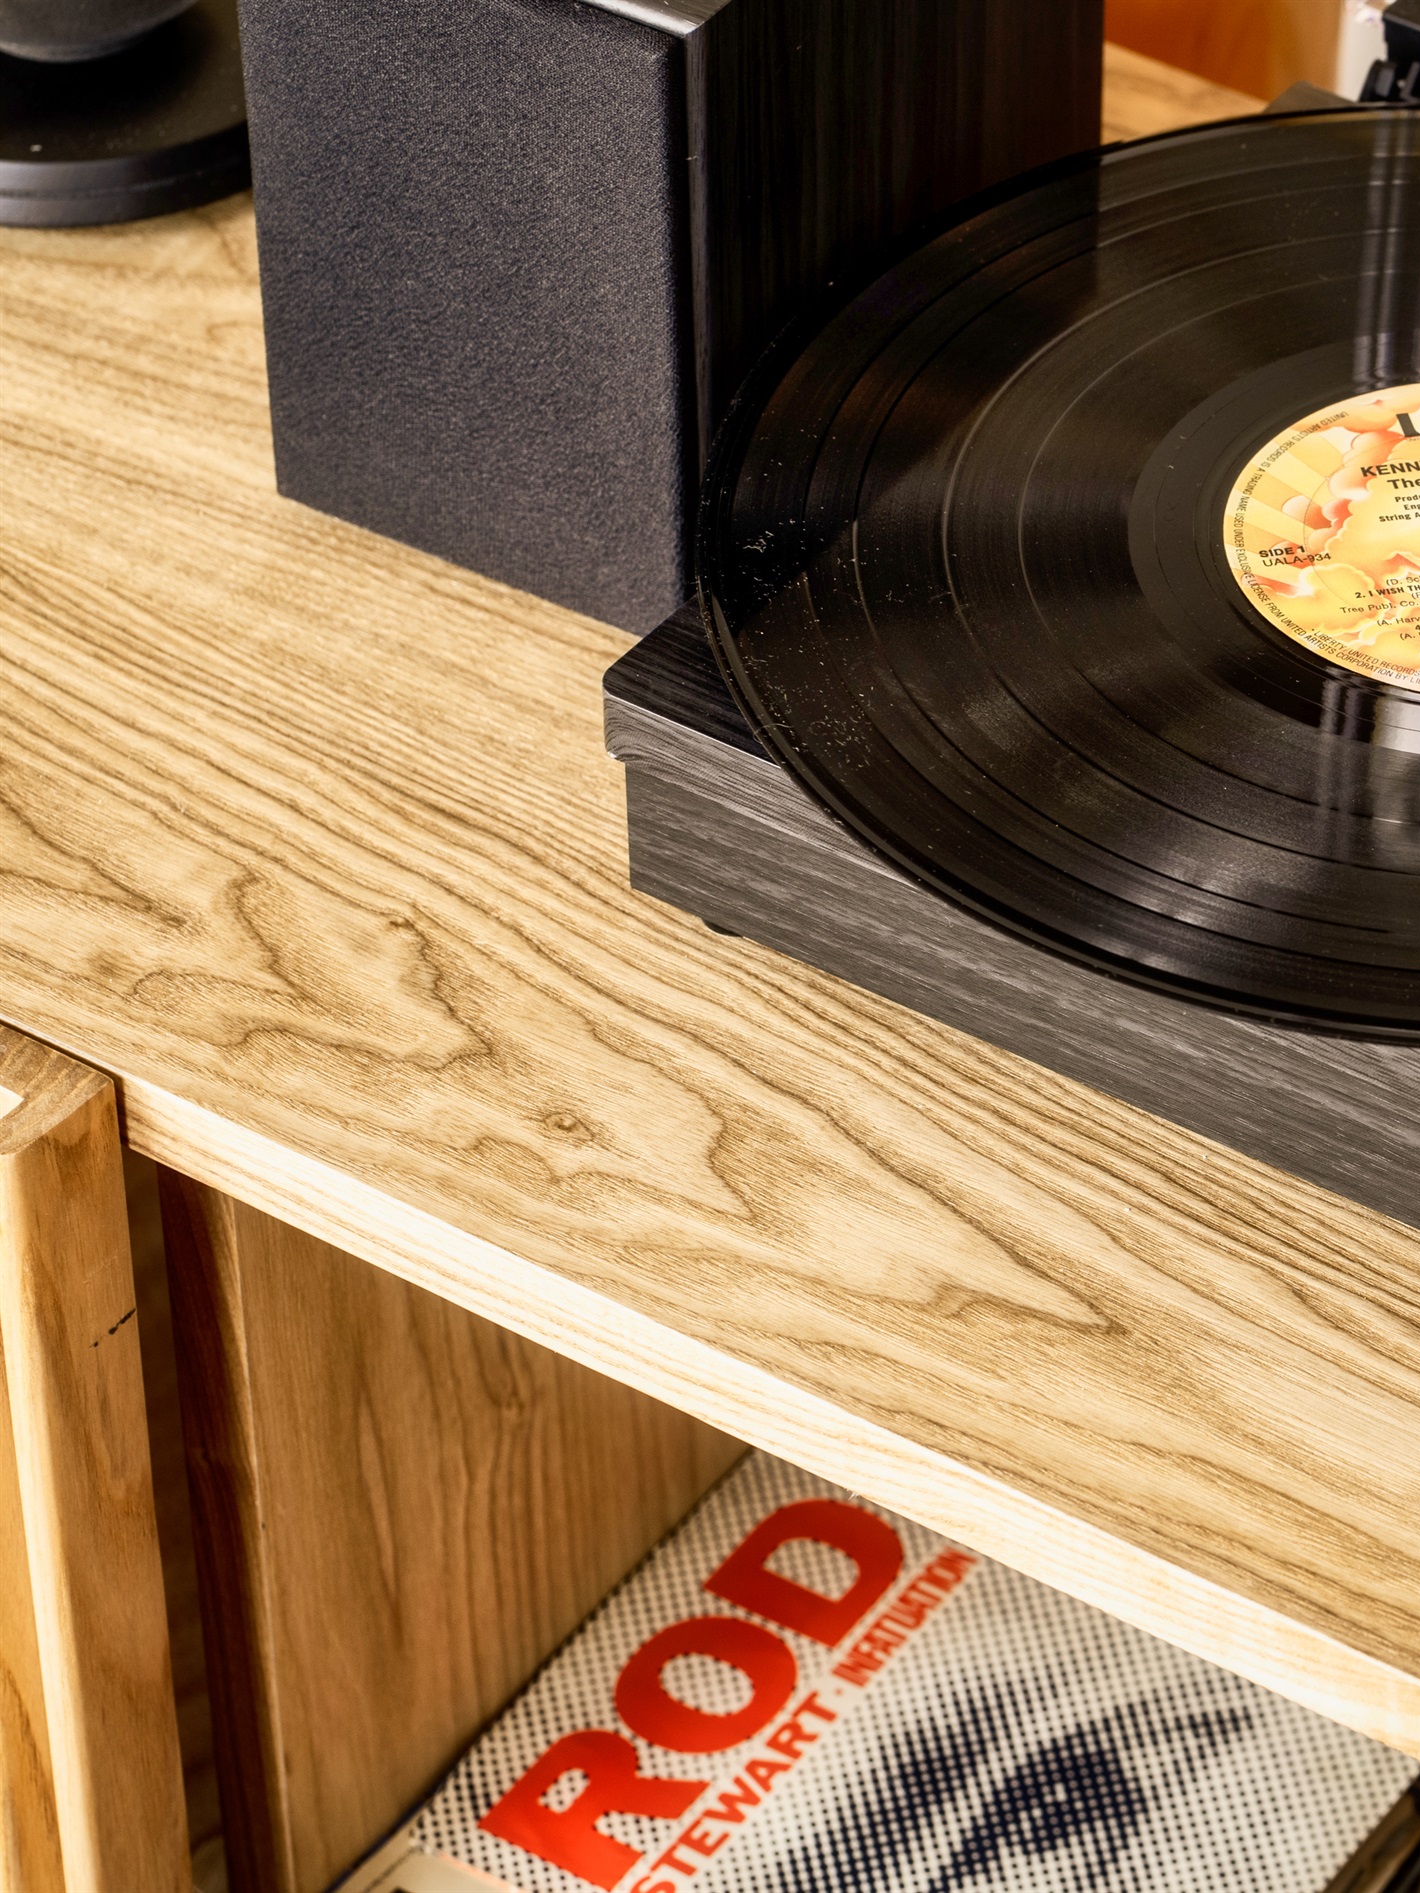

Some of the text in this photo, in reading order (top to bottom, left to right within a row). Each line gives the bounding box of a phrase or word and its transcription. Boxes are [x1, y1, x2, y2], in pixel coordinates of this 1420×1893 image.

[1266, 440, 1296, 463] RECORDS
[1260, 460, 1271, 469] IS
[1242, 472, 1263, 496] TRADING
[1236, 495, 1250, 512] NAME
[1233, 512, 1245, 528] USED
[1379, 513, 1412, 523] String
[1233, 528, 1246, 549] UNDER
[1258, 545, 1306, 558] SIDE 1
[1262, 552, 1332, 567] UALA-934
[1235, 549, 1256, 579] EXCLUSIVE
[1247, 579, 1272, 603] LICENSE
[1386, 578, 1403, 586] (D.
[1355, 591, 1366, 599] 2.
[1376, 586, 1405, 596] WISH
[1265, 600, 1285, 619] FROM
[1340, 604, 1365, 614] Tree
[1368, 602, 1397, 612] Publ.
[1280, 617, 1307, 637] UNITED
[1376, 619, 1393, 627] (A.
[1304, 634, 1337, 655] ARTISTS
[1399, 632, 1416, 641] (A.
[1313, 630, 1380, 665] LIBERTY/UNITED
[1335, 650, 1395, 678] CORPORATION
[1395, 671, 1409, 680] BY
[477, 1497, 905, 1892] ROD
[629, 1545, 978, 1893] STEWART INFATUATION
